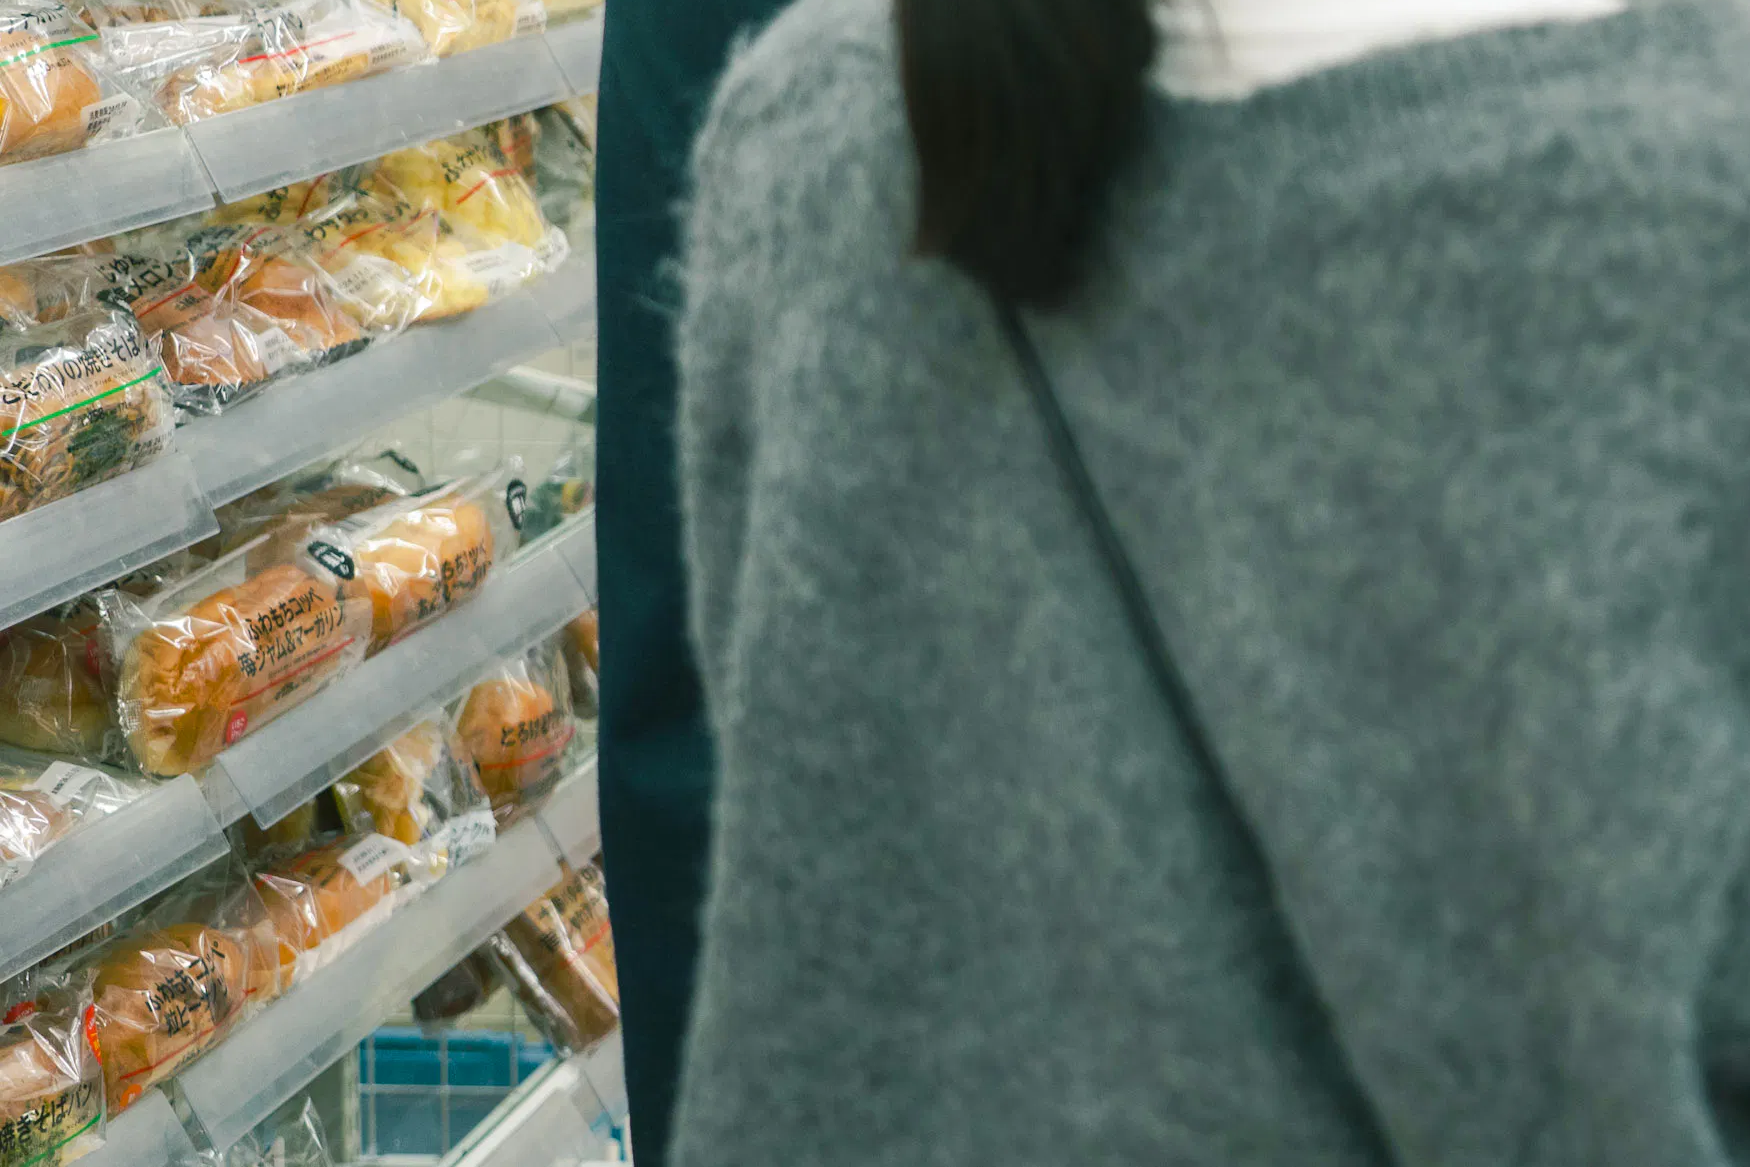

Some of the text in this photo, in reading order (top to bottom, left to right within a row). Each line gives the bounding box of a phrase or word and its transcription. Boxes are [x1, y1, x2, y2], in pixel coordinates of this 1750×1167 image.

[237, 602, 346, 678] 苺ジャム&マーガリン
[245, 586, 324, 642] ふわもちコッペ
